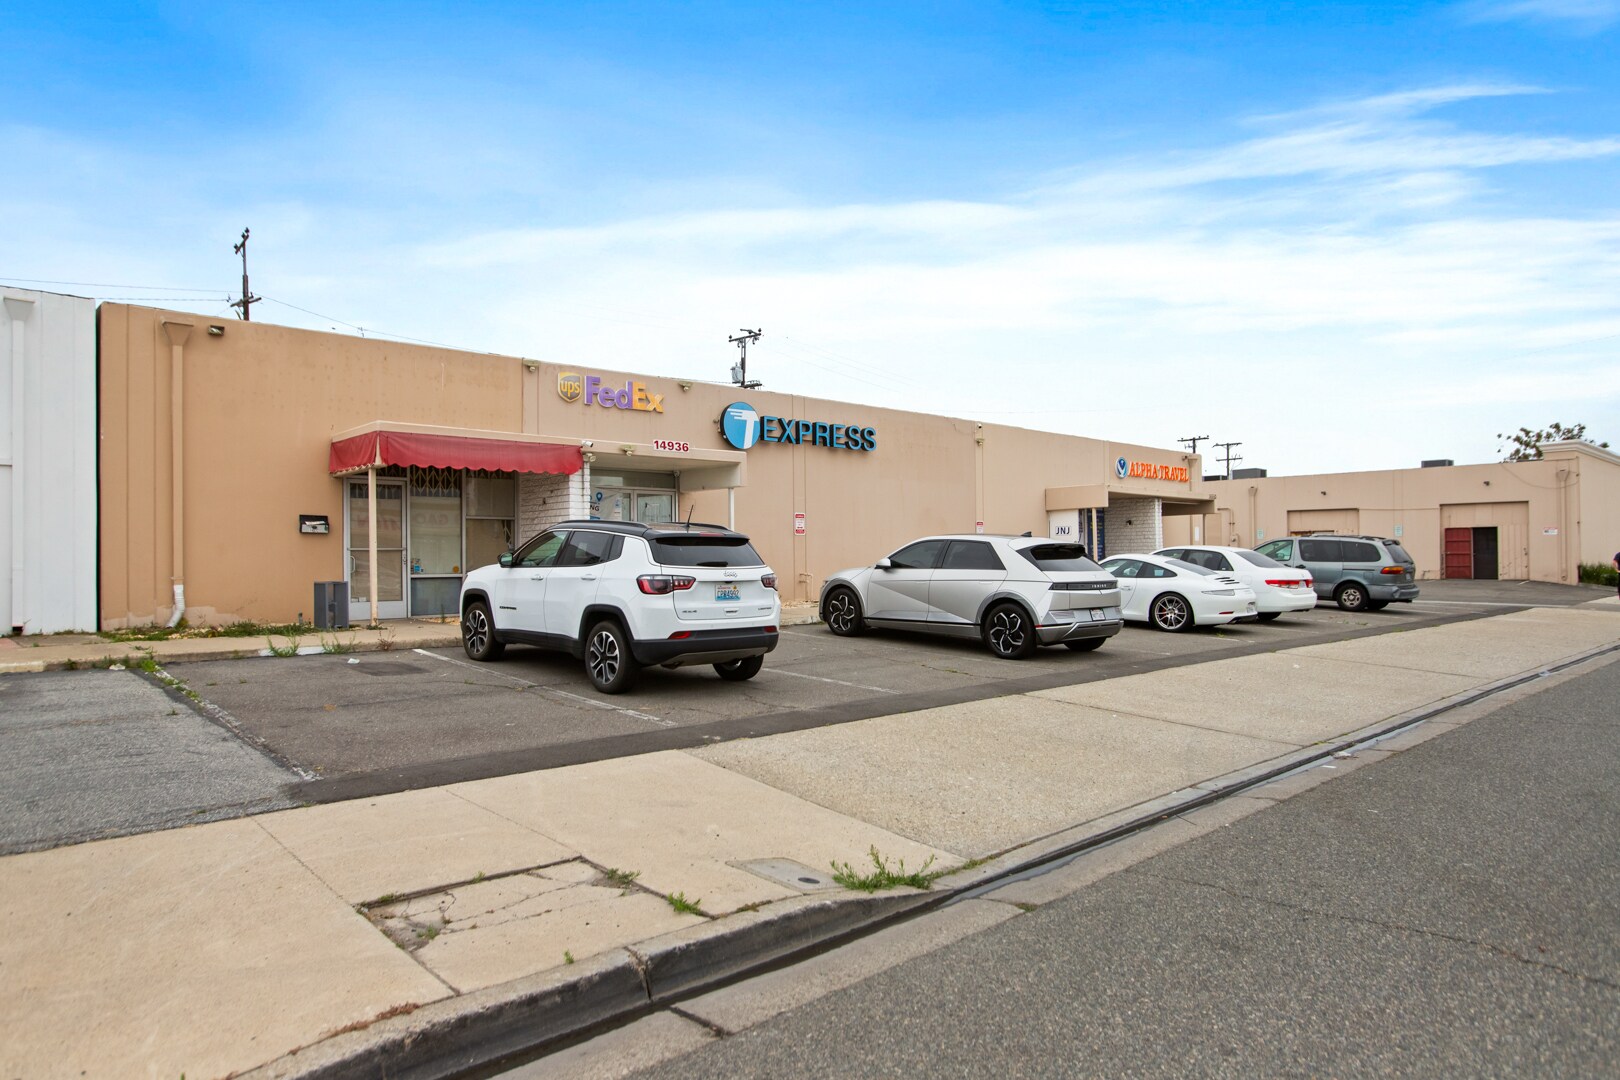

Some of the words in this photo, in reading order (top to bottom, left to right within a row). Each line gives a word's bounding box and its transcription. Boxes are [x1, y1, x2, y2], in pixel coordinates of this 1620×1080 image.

[561, 382, 580, 396] ups
[584, 375, 664, 413] FedEx
[760, 415, 877, 451] EXPRESS
[654, 440, 689, 452] 14936
[1128, 461, 1158, 478] ALPHA
[1158, 465, 1189, 482] TRAVEL
[1055, 526, 1070, 535] JNJ
